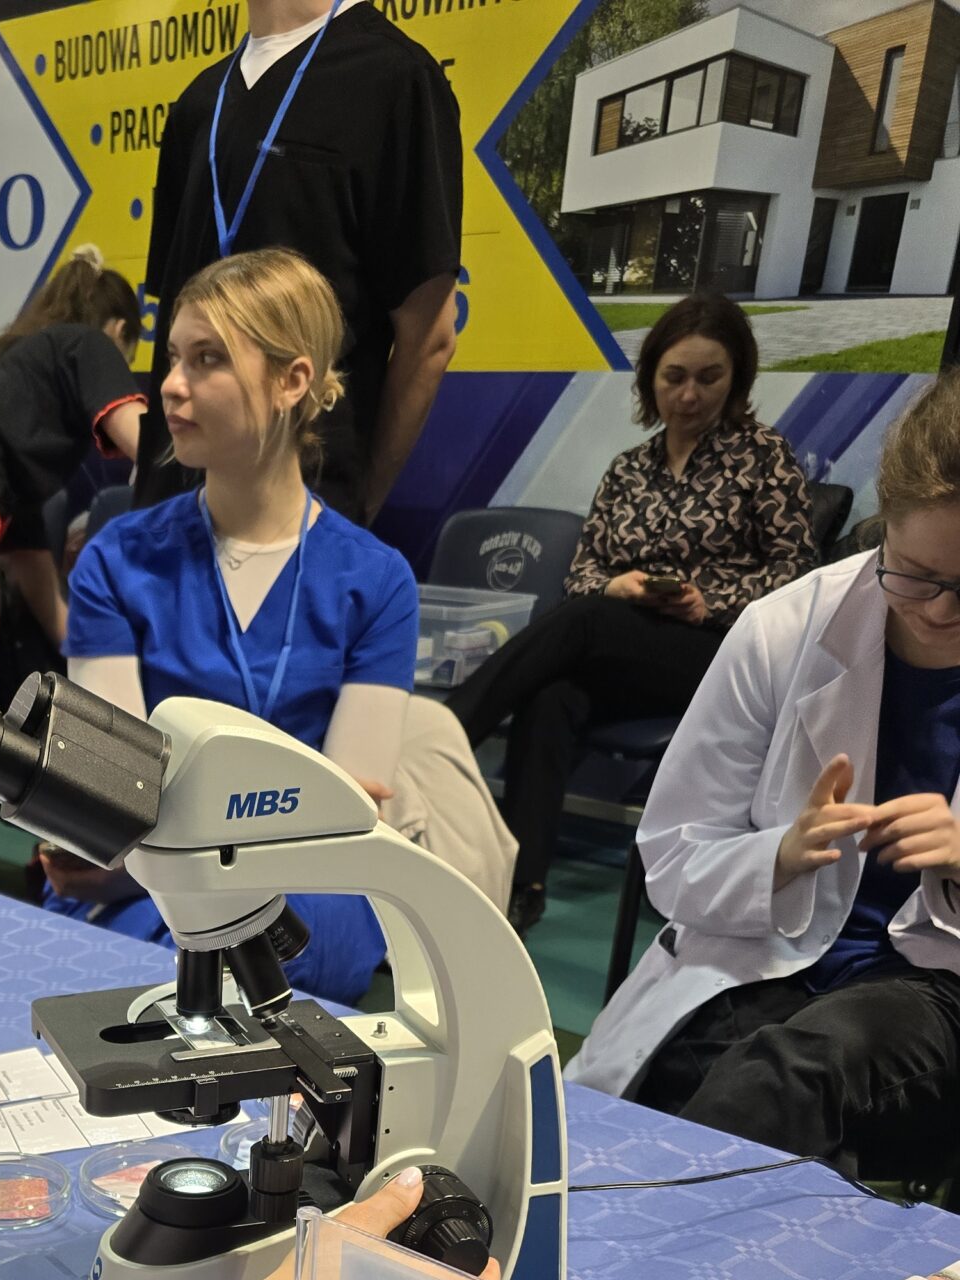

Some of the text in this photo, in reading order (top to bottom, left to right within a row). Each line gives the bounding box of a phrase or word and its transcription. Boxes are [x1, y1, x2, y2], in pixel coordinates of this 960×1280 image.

[54, 0, 239, 83] BUDOWA DOMÓW
[110, 102, 174, 154] PRAC
[226, 788, 301, 820] MB5
